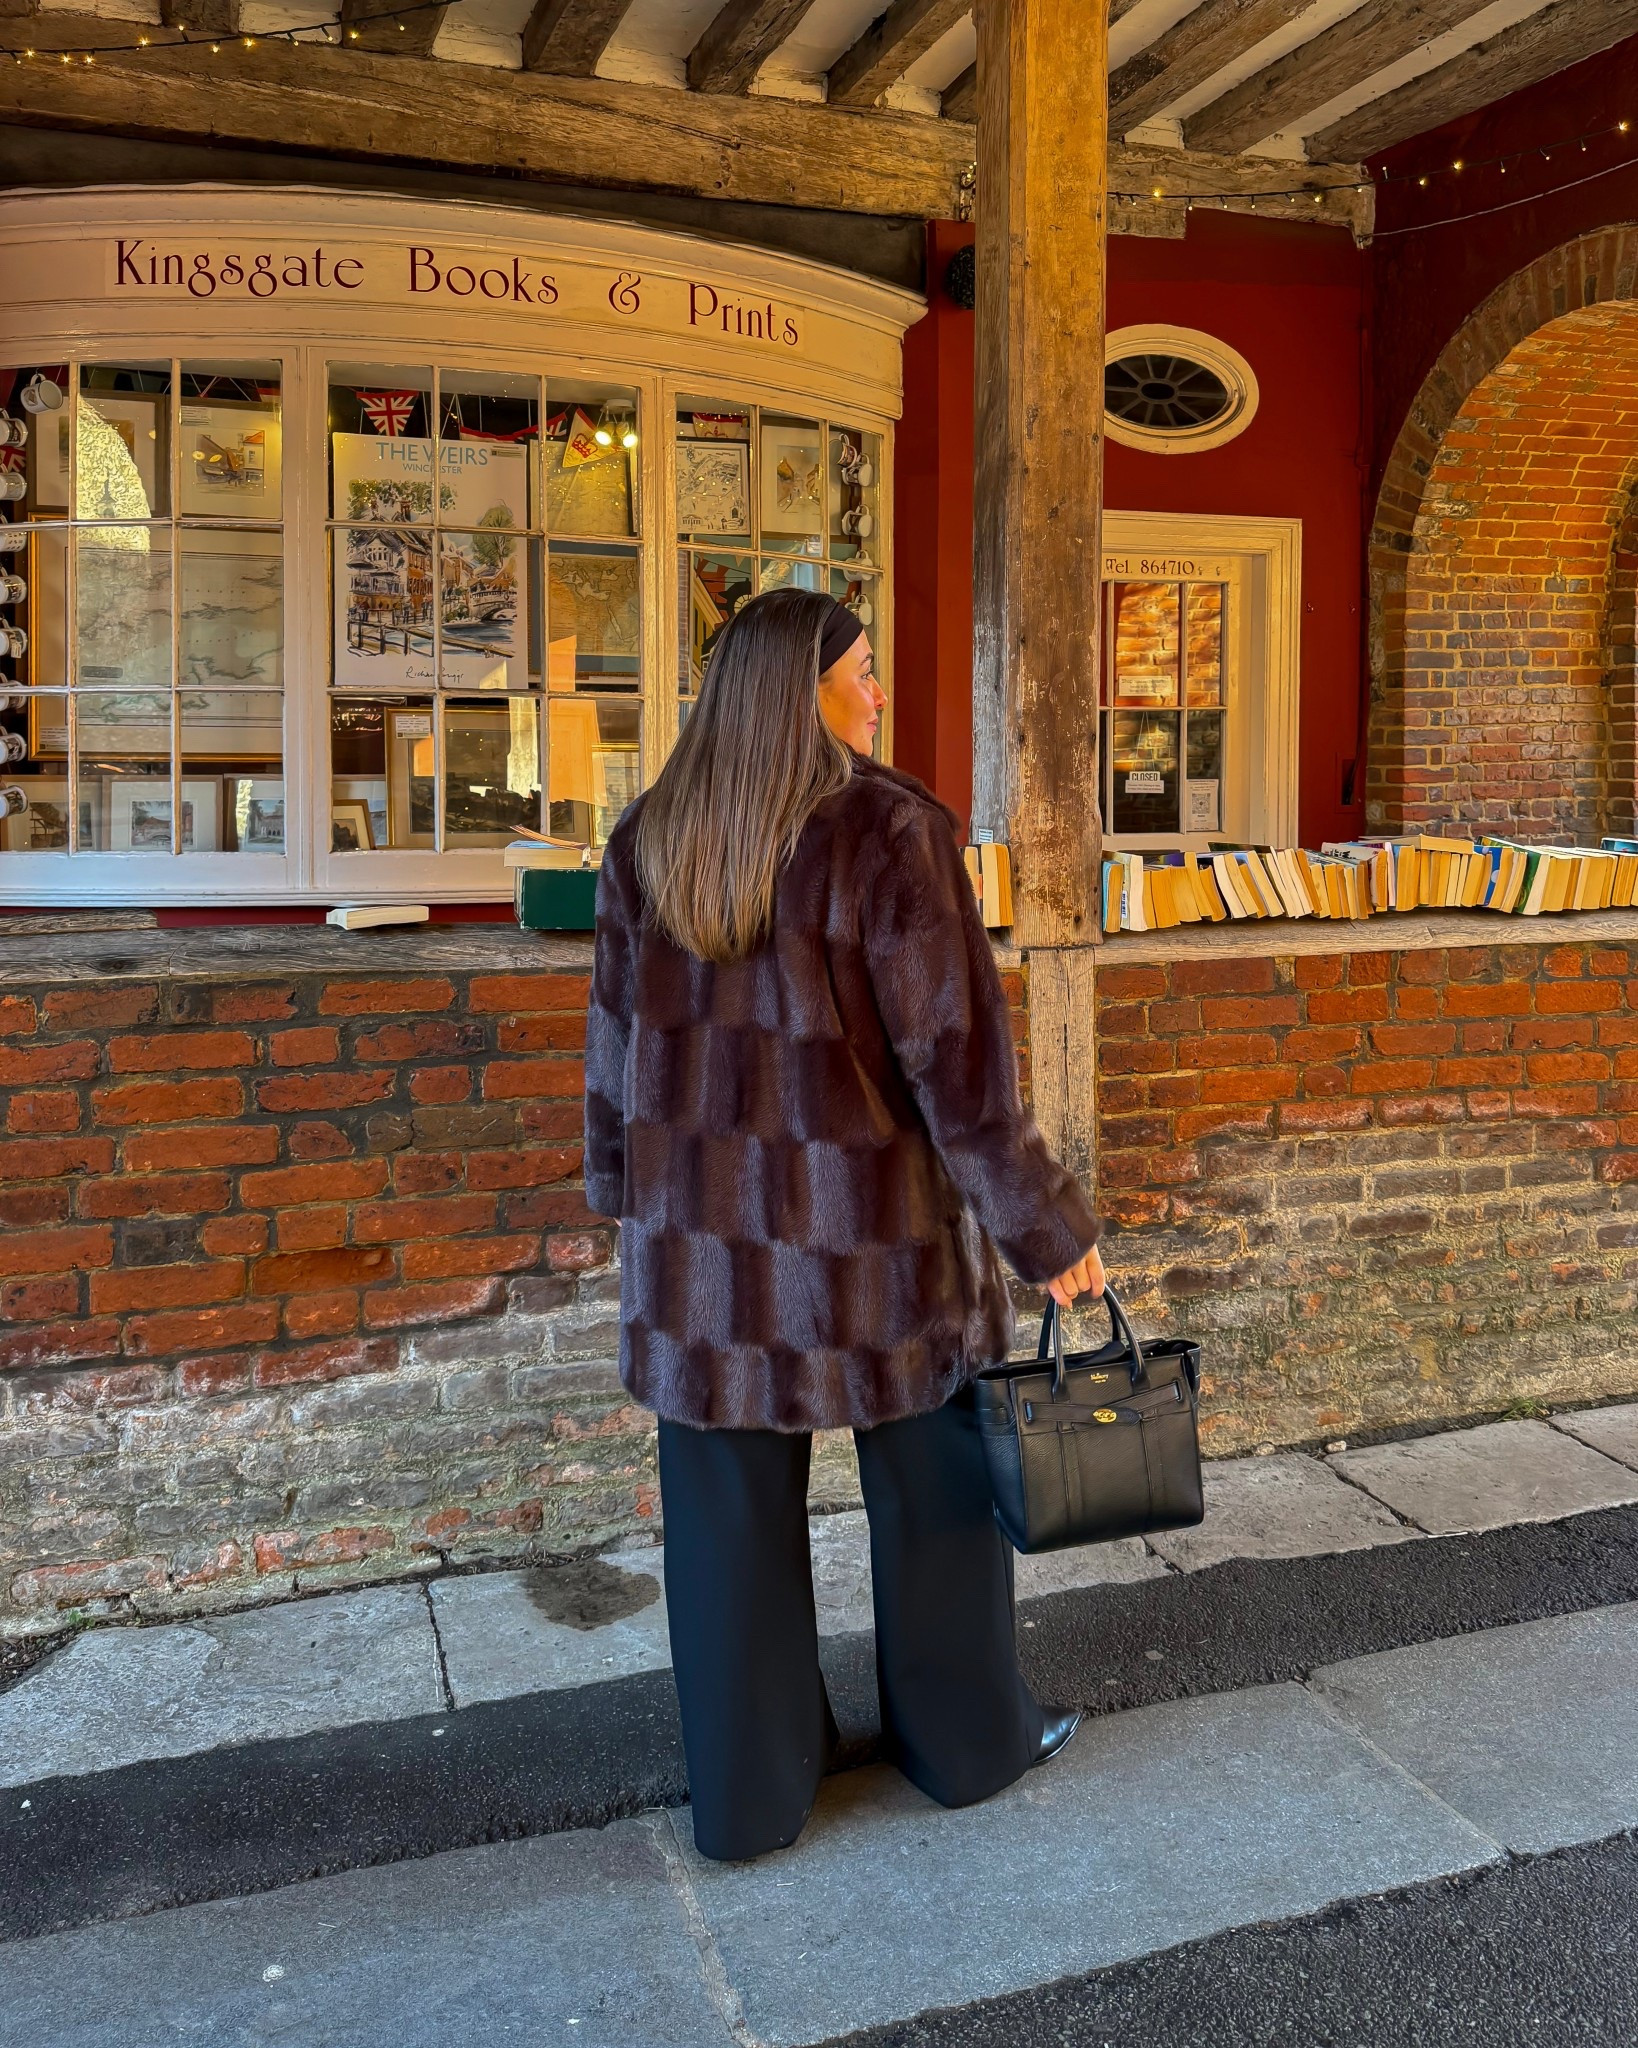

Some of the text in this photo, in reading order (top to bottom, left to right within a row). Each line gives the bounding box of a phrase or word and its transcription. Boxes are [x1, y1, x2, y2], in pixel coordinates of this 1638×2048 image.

[114, 240, 799, 346] Kingsgate Books & Prints
[376, 442, 419, 462] THE
[423, 445, 488, 466] WEIRS
[402, 463, 463, 474] WINCSTER
[1106, 559, 1195, 575] Tel. 864710
[1131, 772, 1158, 782] CLOSED
